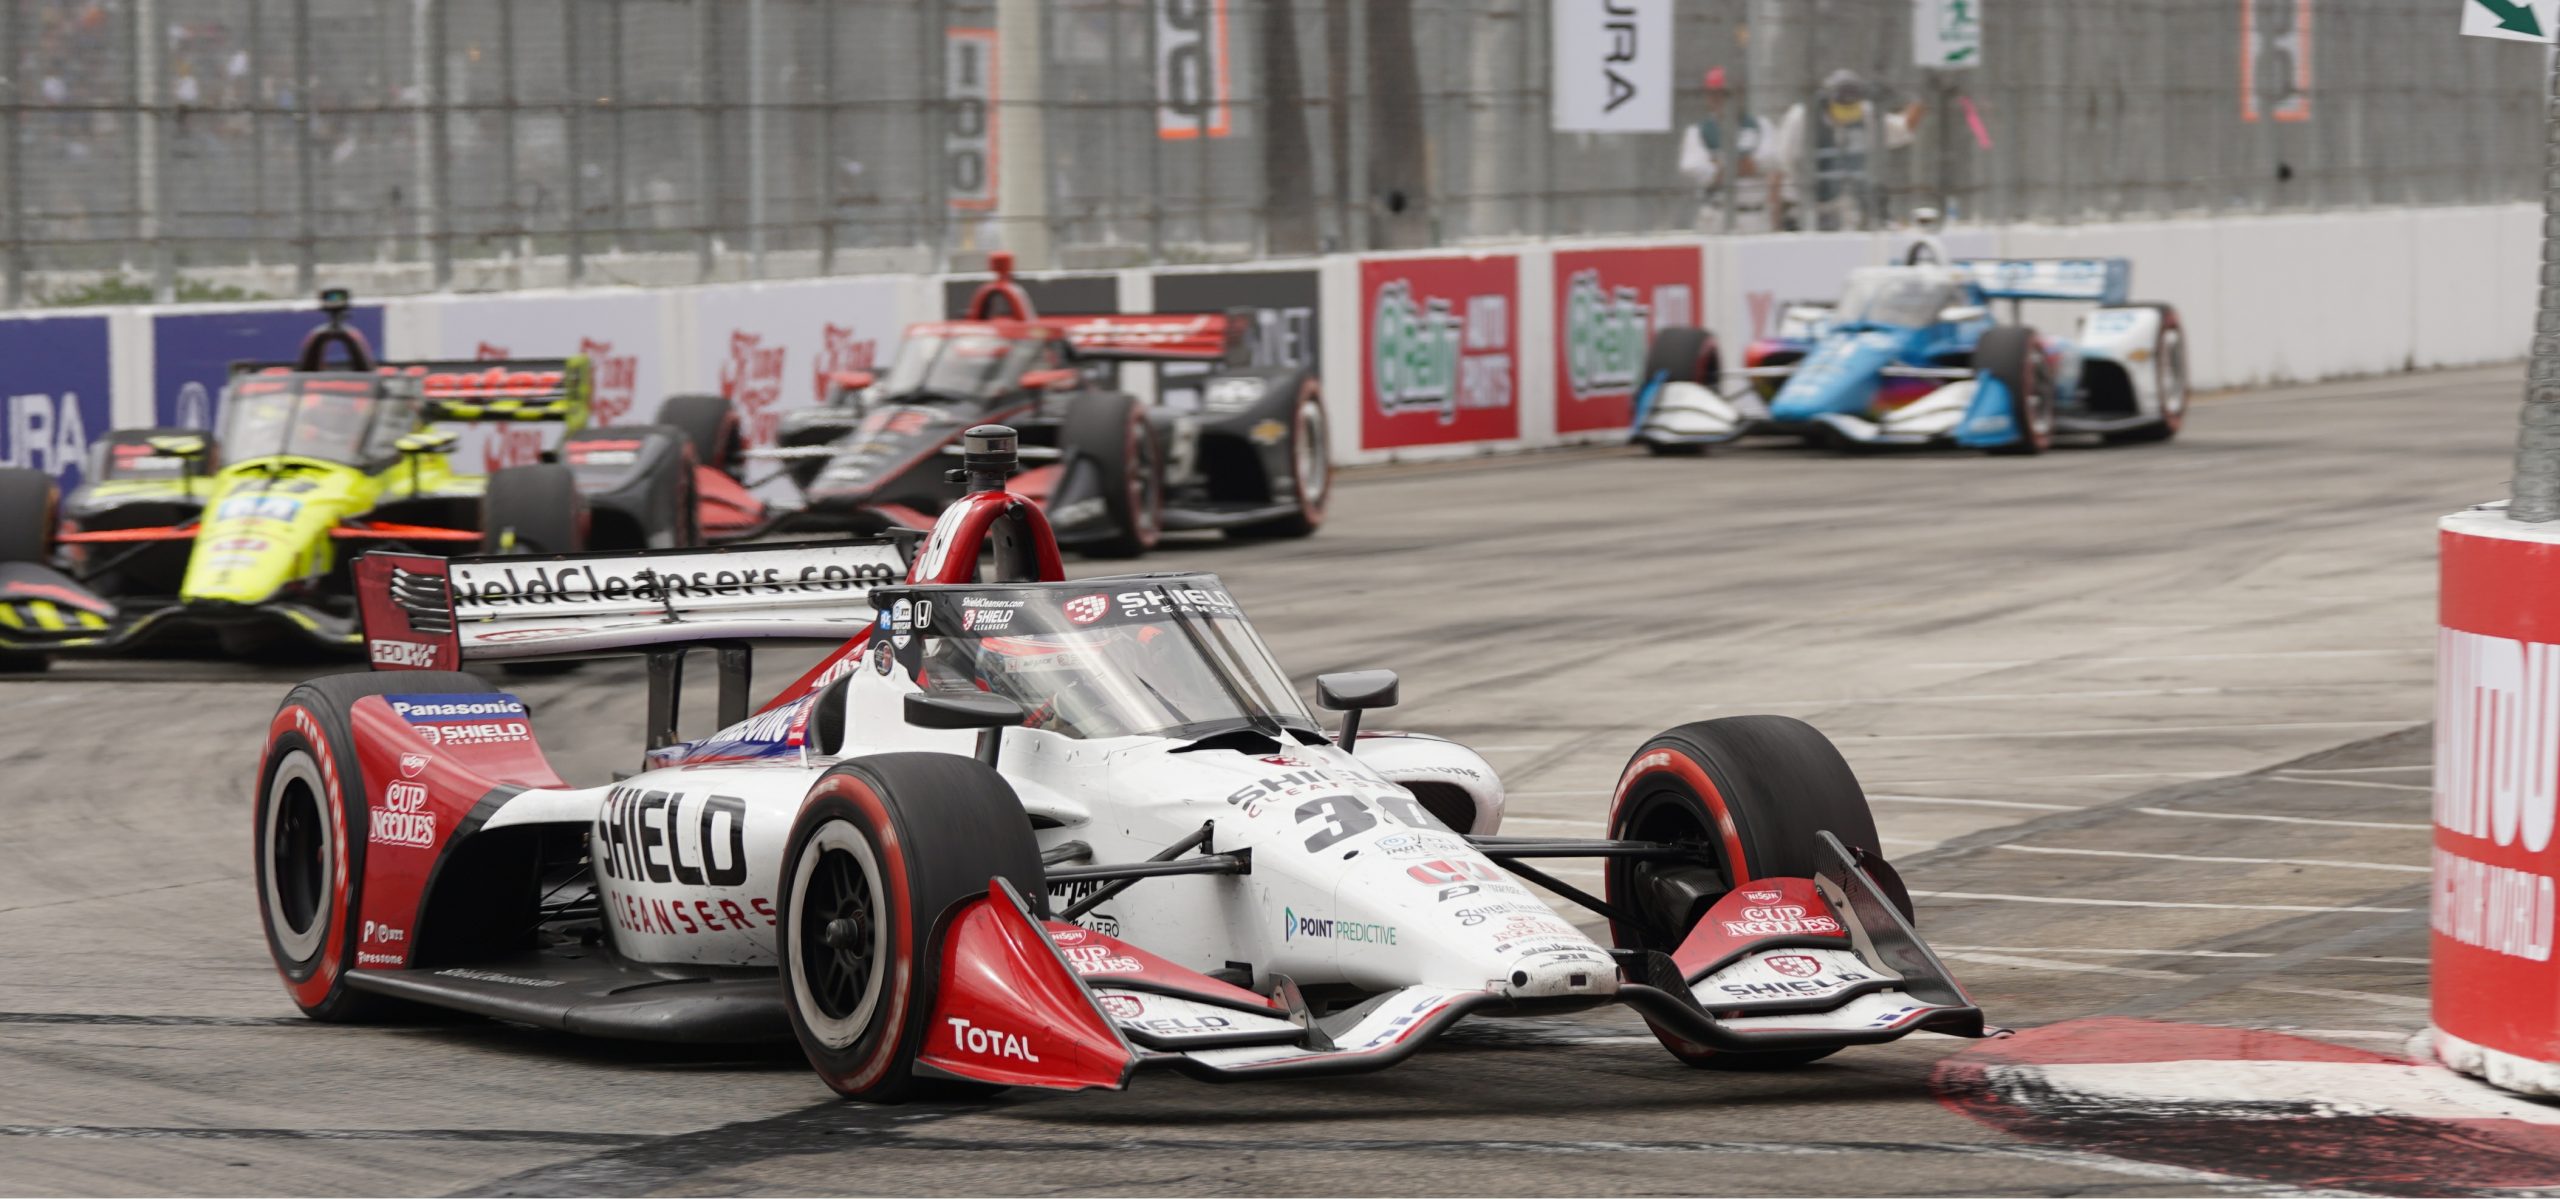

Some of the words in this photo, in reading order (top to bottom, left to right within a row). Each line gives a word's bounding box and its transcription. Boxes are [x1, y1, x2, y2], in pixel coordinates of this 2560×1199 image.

[452, 562, 895, 607] ieldCleansers.com
[1117, 589, 1234, 609] SHIELD
[976, 609, 1013, 623] SHIELD
[393, 700, 522, 716] Panasonic
[441, 723, 528, 739] SHIELD
[386, 783, 426, 812] CUP
[371, 809, 435, 845] NOODLES
[599, 786, 747, 886] SHIELD
[612, 890, 776, 935] CLEANSERS
[1723, 916, 1839, 937] NOODLES
[1742, 905, 1806, 921] CUP
[1300, 917, 1334, 939] POINT
[1336, 921, 1397, 946] PREDICTIVE
[948, 1017, 1039, 1063] TOTAL
